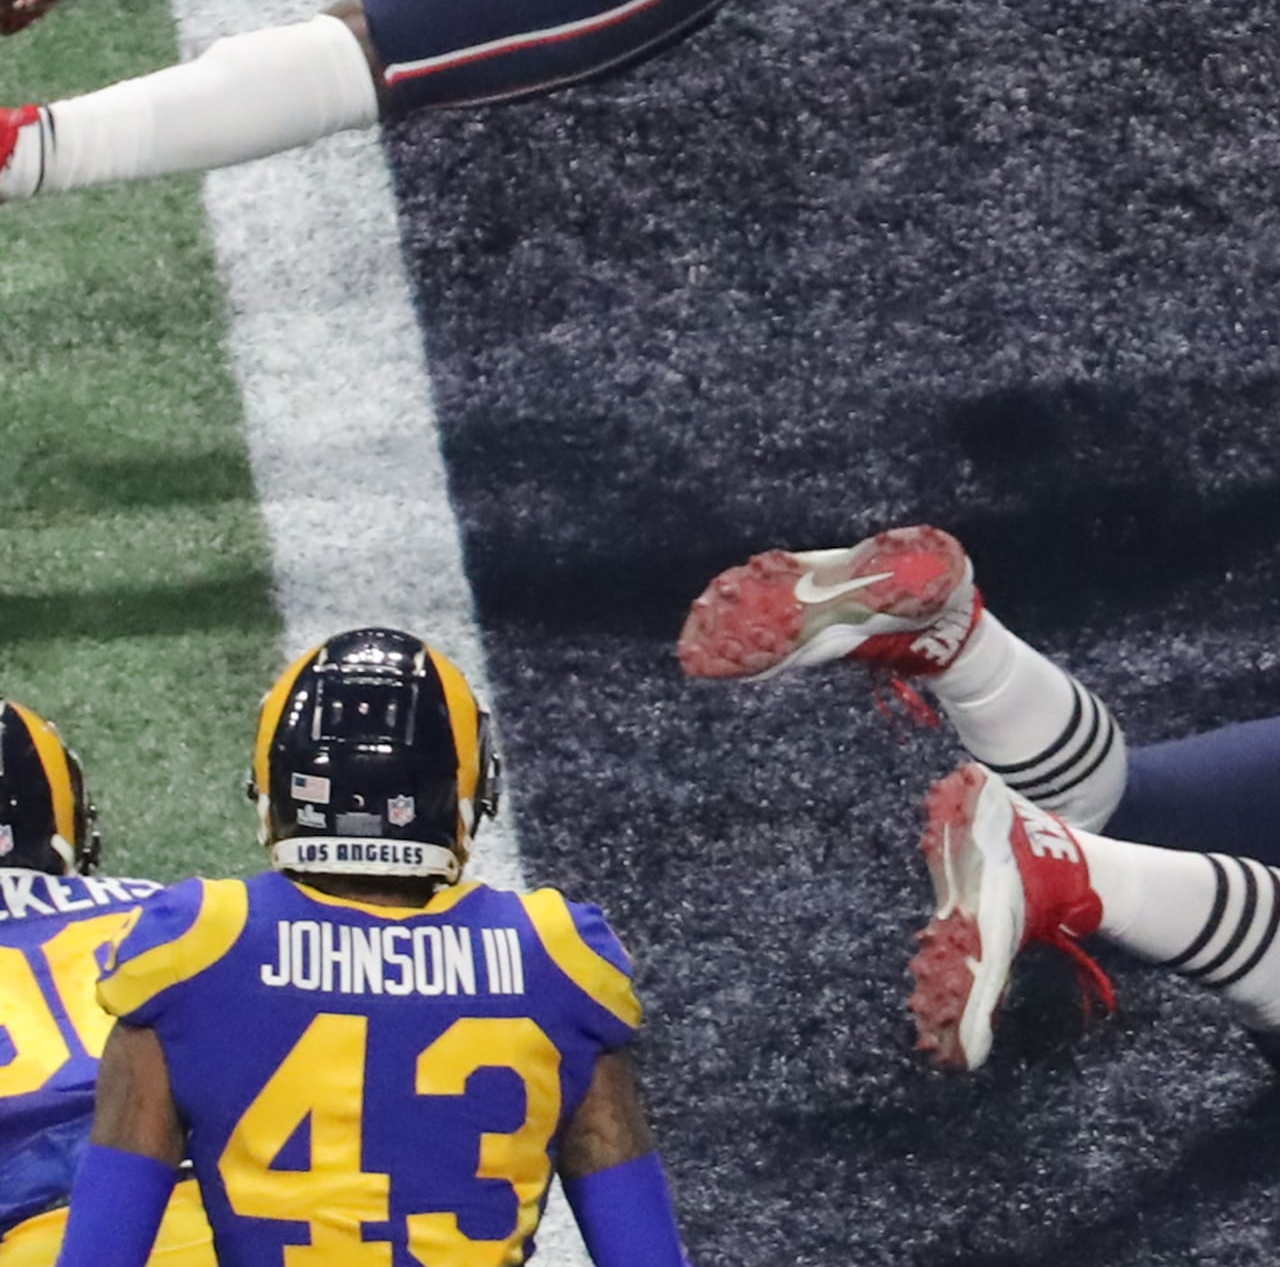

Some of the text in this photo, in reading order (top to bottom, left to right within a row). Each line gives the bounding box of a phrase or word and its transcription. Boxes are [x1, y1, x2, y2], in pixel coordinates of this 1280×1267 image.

[297, 843, 424, 865] LOS ANGELES
[260, 919, 525, 996] JOHNSON III
[218, 1012, 562, 1267] 43
